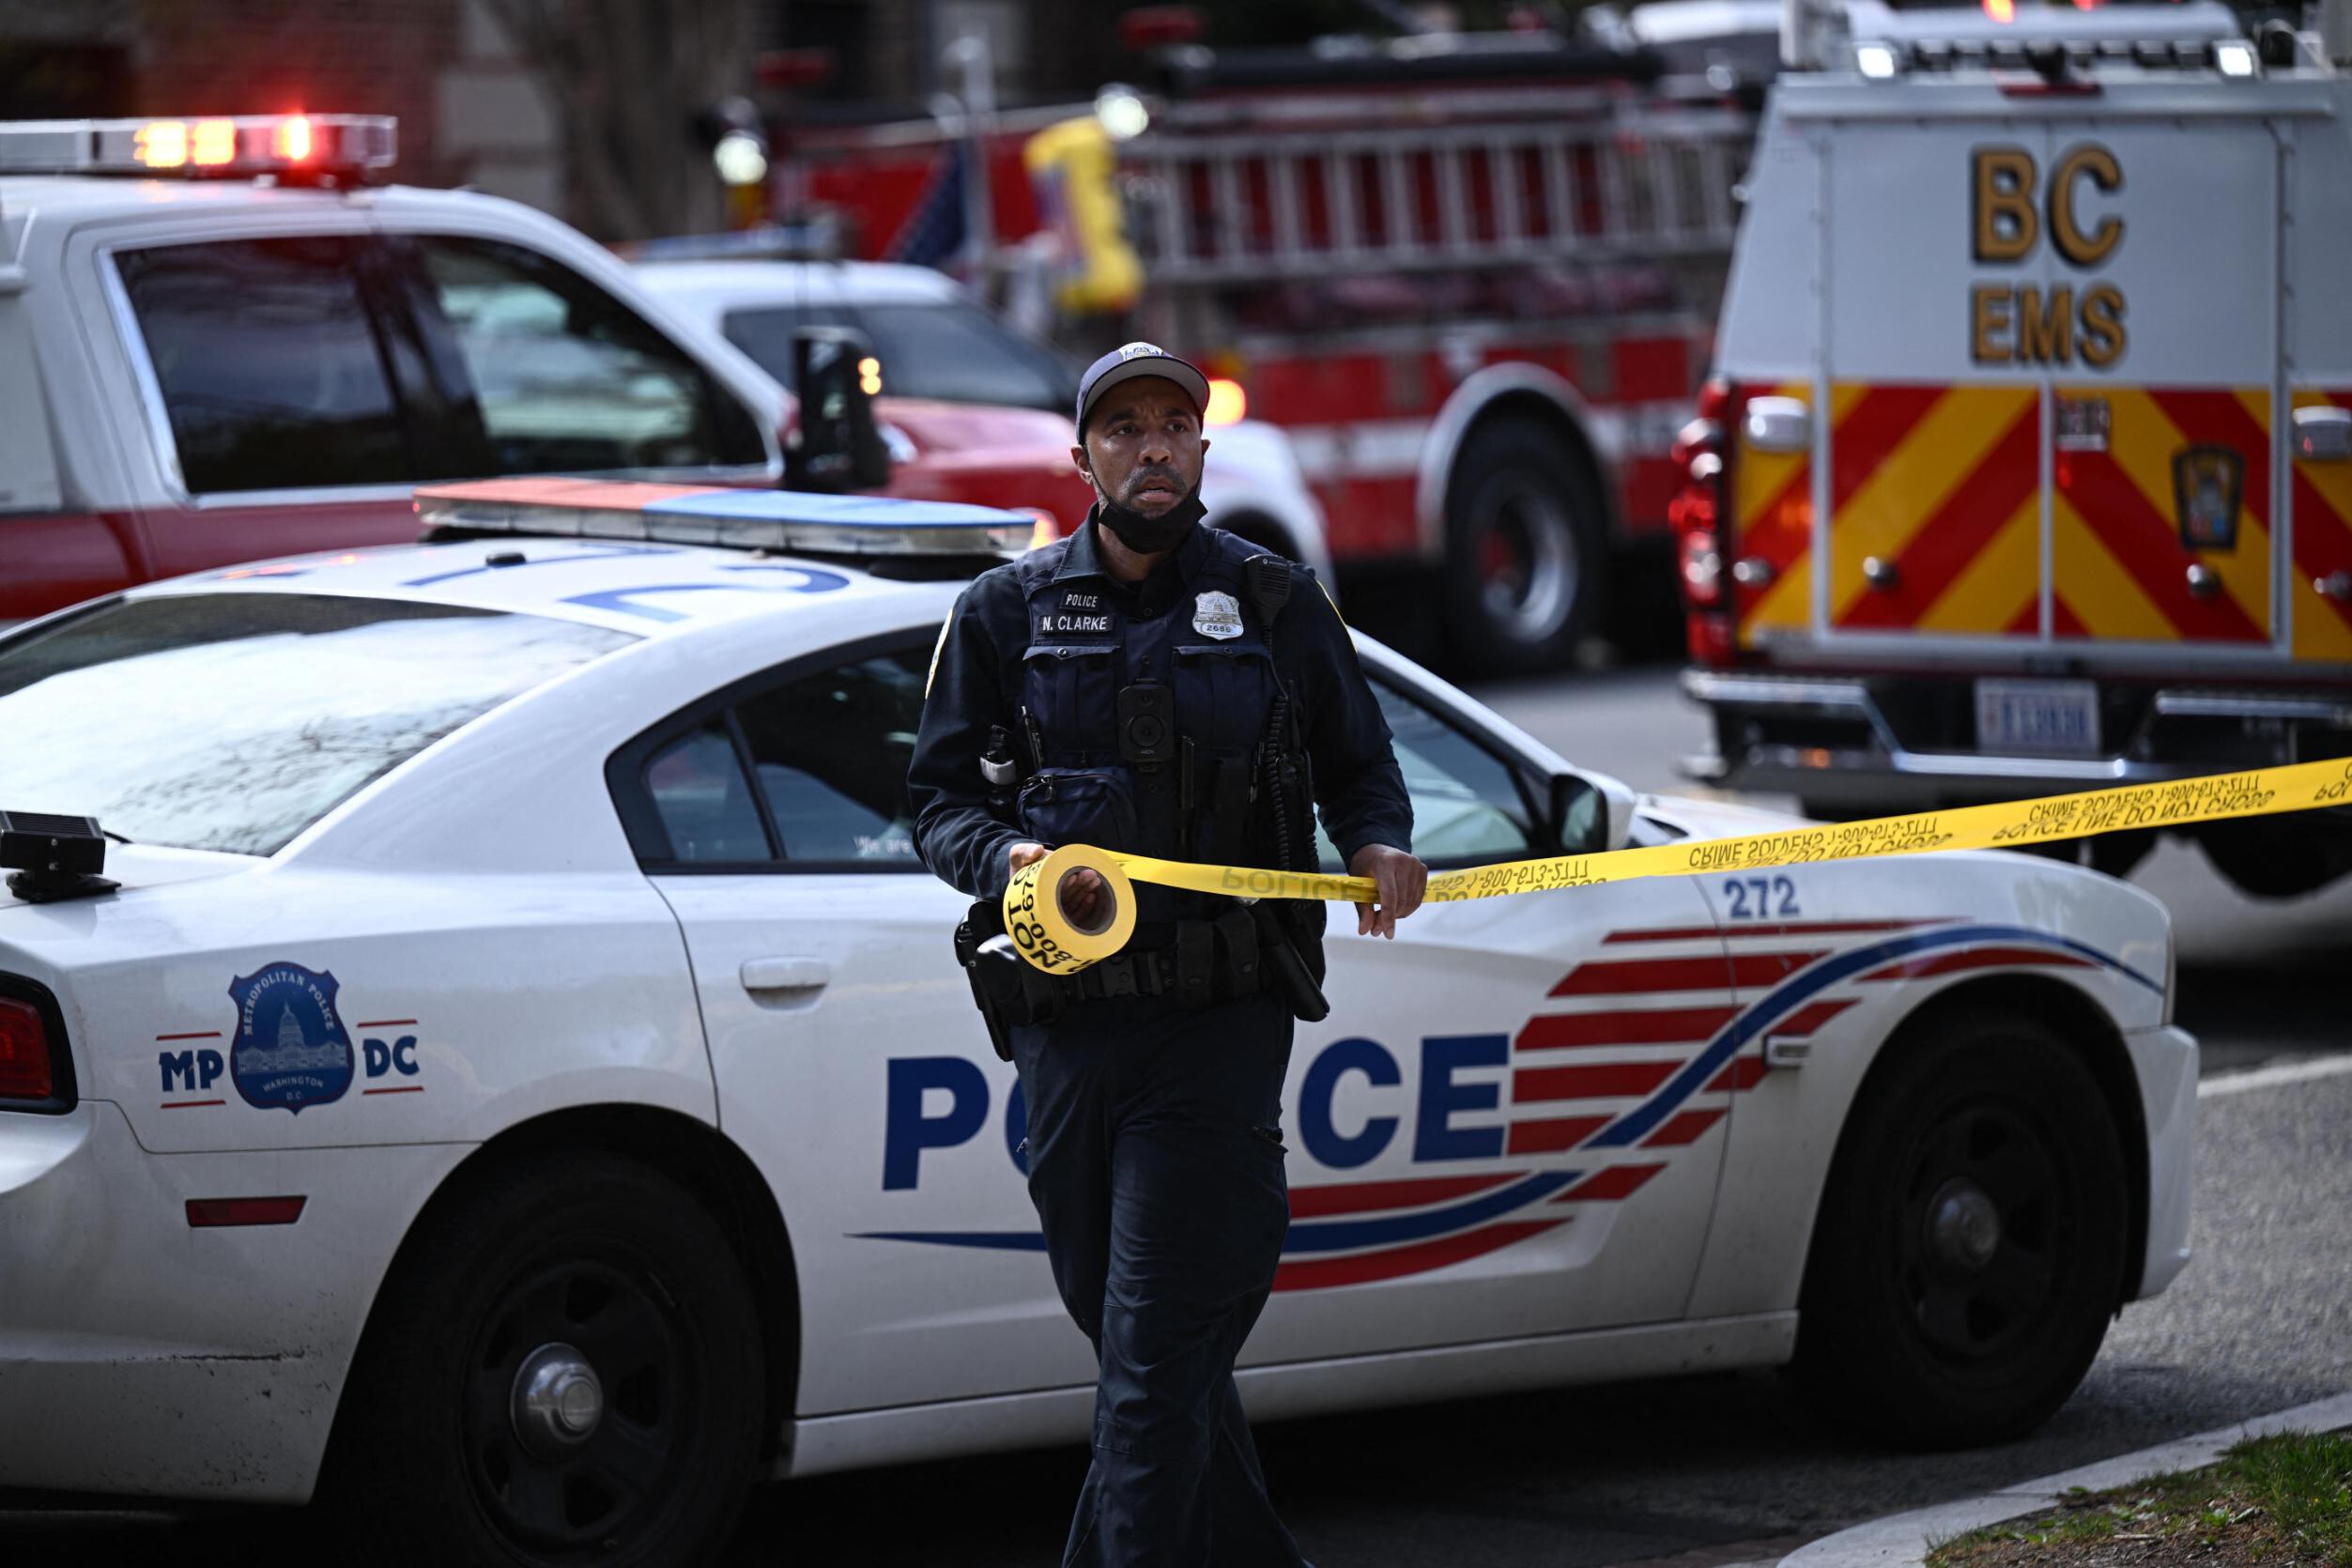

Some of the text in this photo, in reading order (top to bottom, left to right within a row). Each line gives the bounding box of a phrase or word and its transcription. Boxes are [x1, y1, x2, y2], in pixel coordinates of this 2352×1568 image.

[1972, 144, 2123, 270] BC
[1972, 284, 2128, 368] EMS
[1042, 616, 1108, 632] N. CLARKE
[1066, 593, 1099, 608] POLICE
[1723, 872, 1801, 918] 272
[1007, 900, 1060, 969] NOT
[243, 971, 335, 1037] METROPOLITAN POLICE
[159, 1035, 421, 1092] MP DC
[263, 1075, 324, 1093] WASHINGTON
[883, 1034, 1510, 1191] PCE
